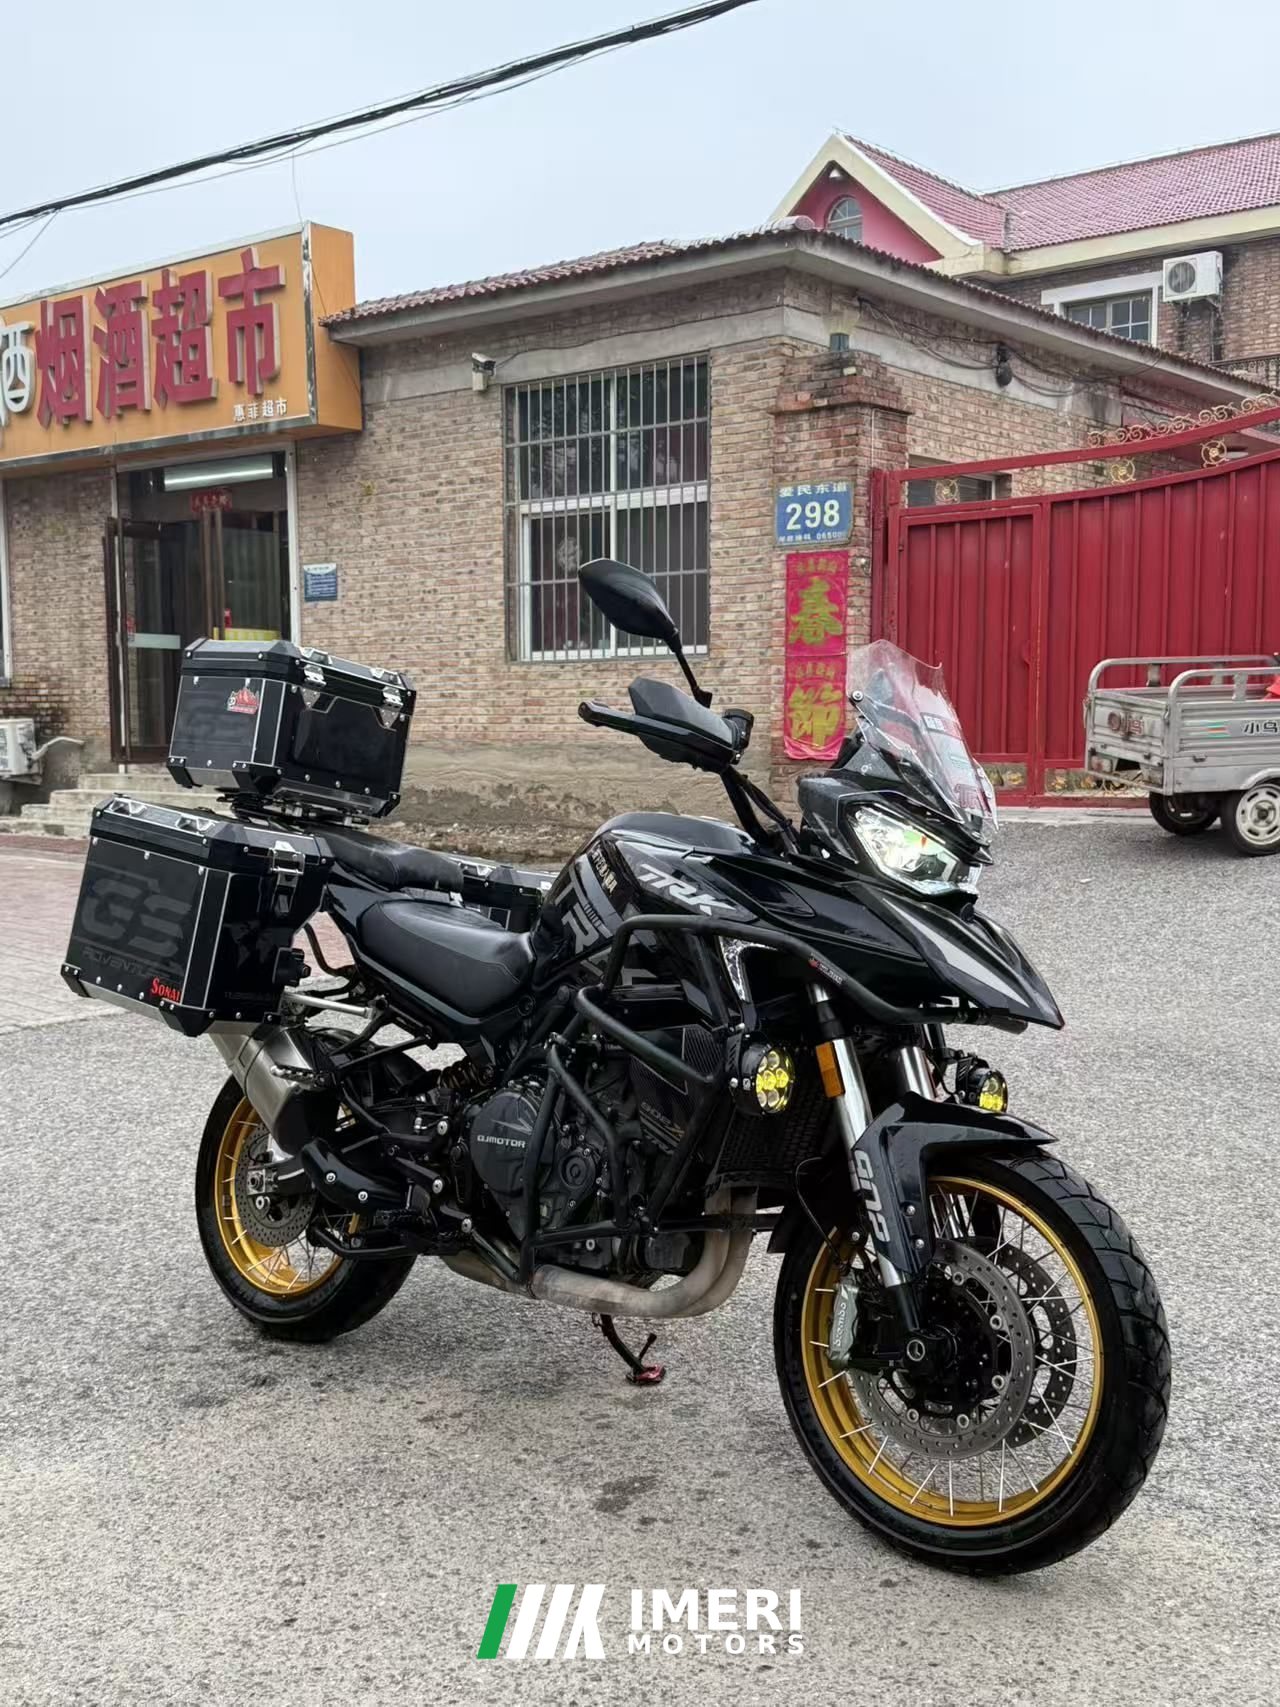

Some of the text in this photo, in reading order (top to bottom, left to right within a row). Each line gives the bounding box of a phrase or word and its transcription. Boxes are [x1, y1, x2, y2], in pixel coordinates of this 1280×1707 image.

[35, 246, 287, 429] 烟酒超市
[785, 499, 840, 531] 298
[637, 863, 736, 916] TRK
[81, 878, 192, 957] GS
[476, 1134, 527, 1149] QJMOTOR
